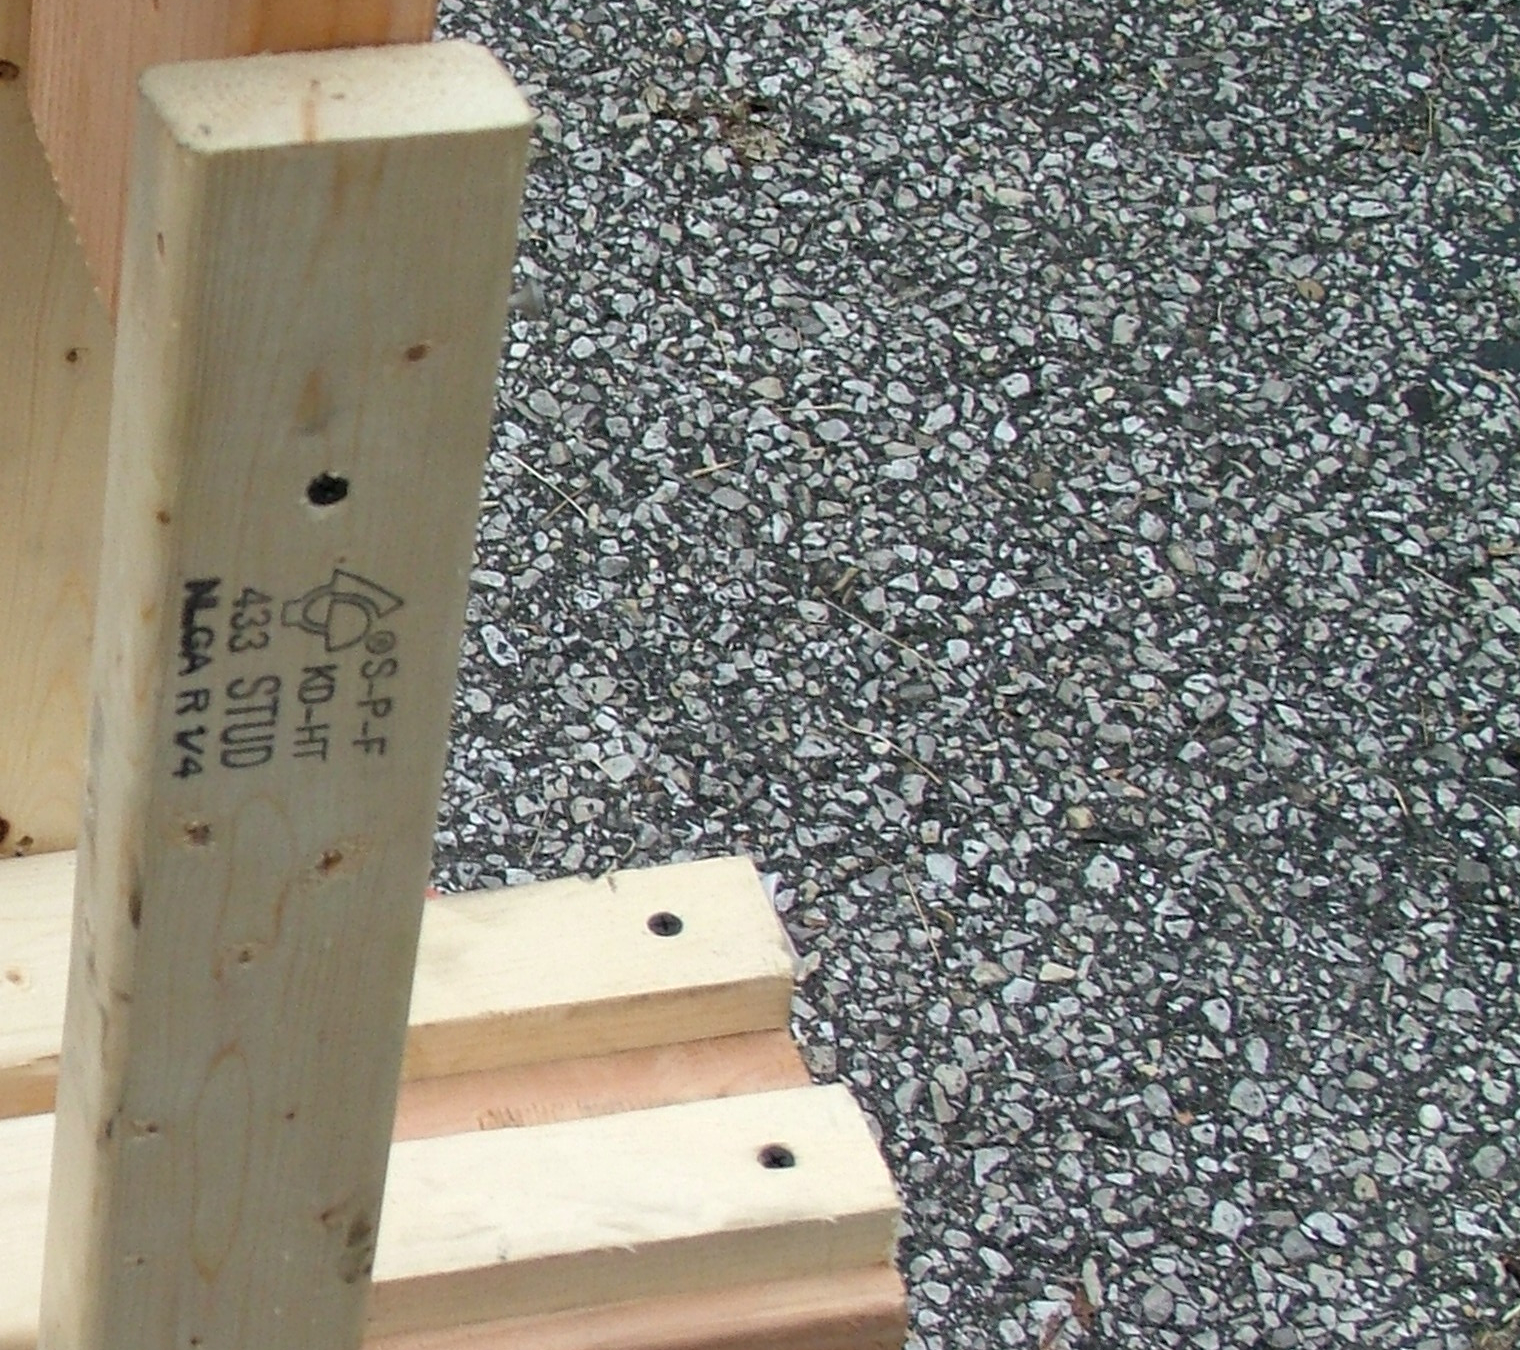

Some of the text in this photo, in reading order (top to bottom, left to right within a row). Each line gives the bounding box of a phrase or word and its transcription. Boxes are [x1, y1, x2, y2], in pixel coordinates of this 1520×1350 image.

[219, 586, 282, 770] 433 STUD
[292, 663, 339, 762] KD-HT
